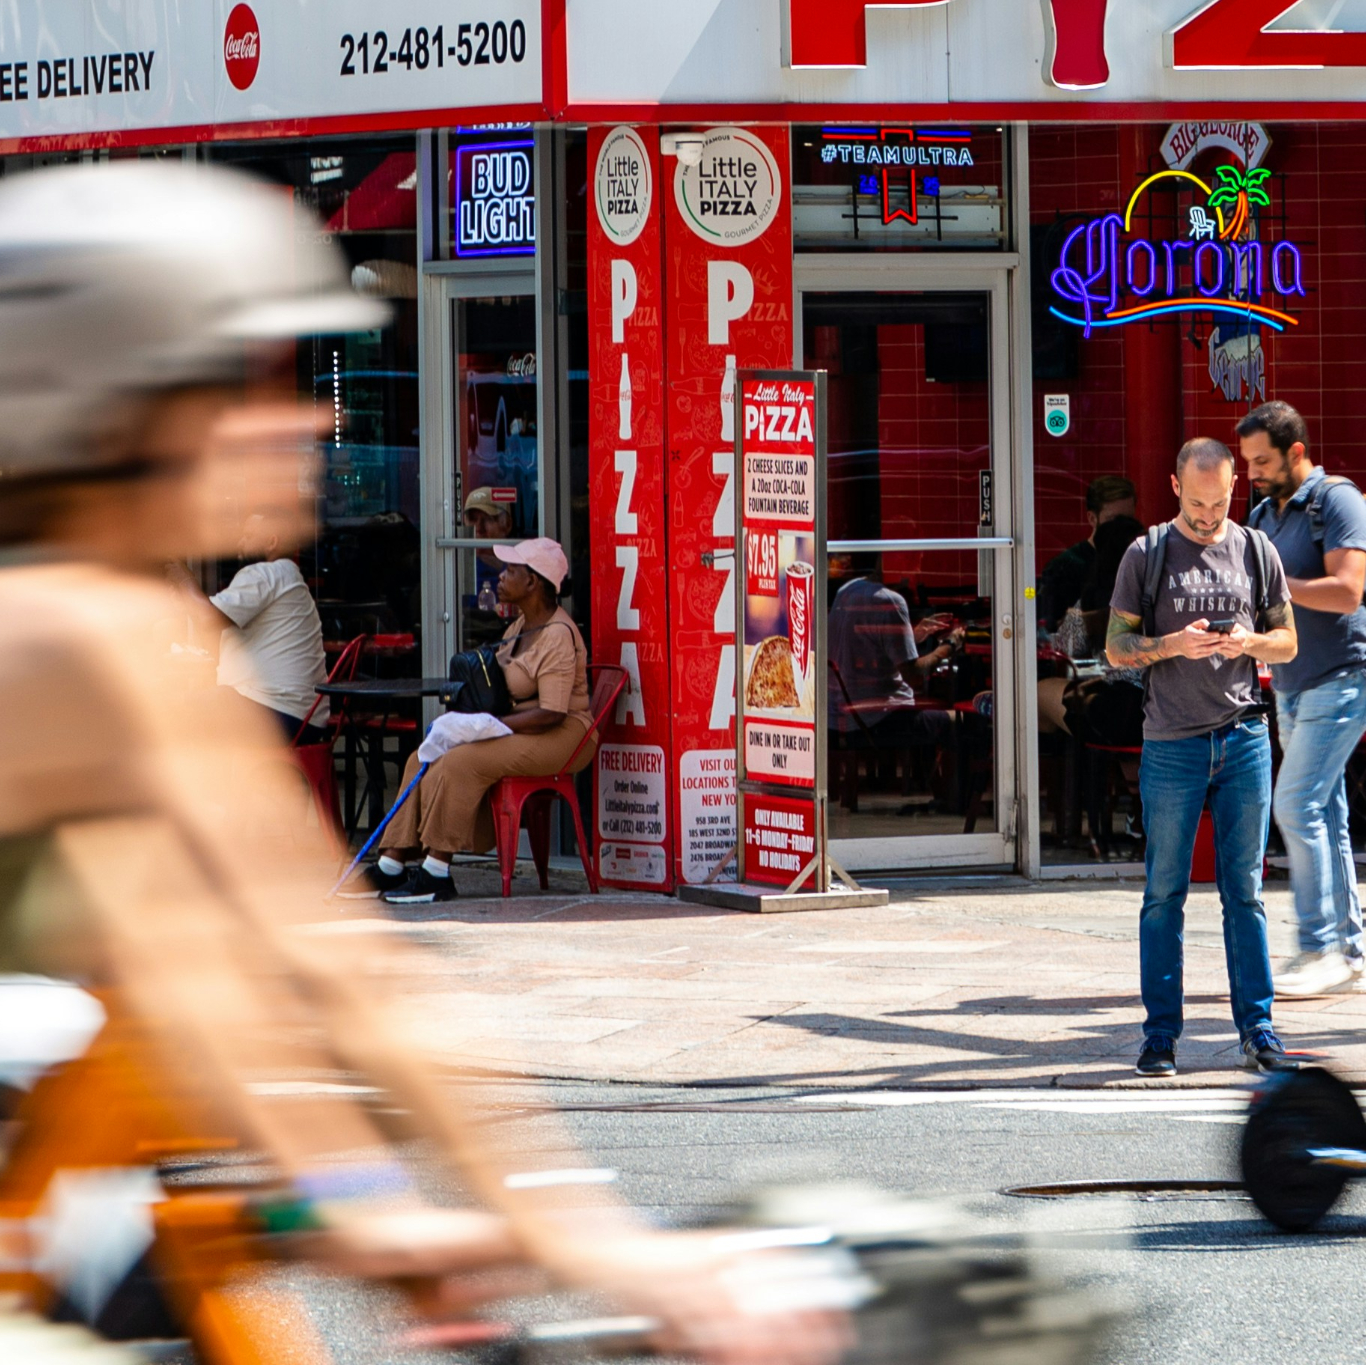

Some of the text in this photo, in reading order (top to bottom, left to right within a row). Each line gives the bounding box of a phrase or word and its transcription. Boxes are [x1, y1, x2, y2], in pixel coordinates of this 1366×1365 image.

[339, 20, 526, 76] 212-481-5200
[37, 50, 154, 99] DELIVERY
[821, 144, 974, 166] #TEAMULTRA
[472, 152, 529, 198] BUD
[607, 156, 639, 177] Little
[699, 157, 757, 178] Little
[607, 178, 639, 198] ITALY
[699, 180, 757, 199] ITALY
[607, 199, 639, 215] PIZZA
[700, 201, 757, 216] PIZZA
[461, 197, 535, 244] LIGHT
[1051, 213, 1306, 338] Corona
[753, 383, 779, 402] Little
[782, 384, 805, 406] Italy
[747, 458, 808, 475] 2 CHEESE SLICES AND
[757, 479, 771, 493] 20oz
[772, 479, 805, 495] COCA-COLA
[748, 497, 809, 515] FOUNTAIN BEVERAGE
[747, 530, 776, 578] $7.95
[1169, 569, 1253, 590] AMERICAN
[1173, 596, 1247, 613] WHISKEY
[749, 731, 810, 752] DINE IN OR TAKE OUT
[601, 750, 662, 773] FREE DELIVERY
[700, 758, 736, 771] VISIT OU
[772, 753, 787, 769] ONLY
[682, 776, 729, 789] LOCATIONS
[702, 794, 736, 807] NEW YO
[695, 815, 731, 825] 958 3RD AVE
[754, 808, 804, 831] ONLY AVAILABLE
[699, 828, 715, 837] WEST
[759, 850, 801, 872] NO HOLIDAYS
